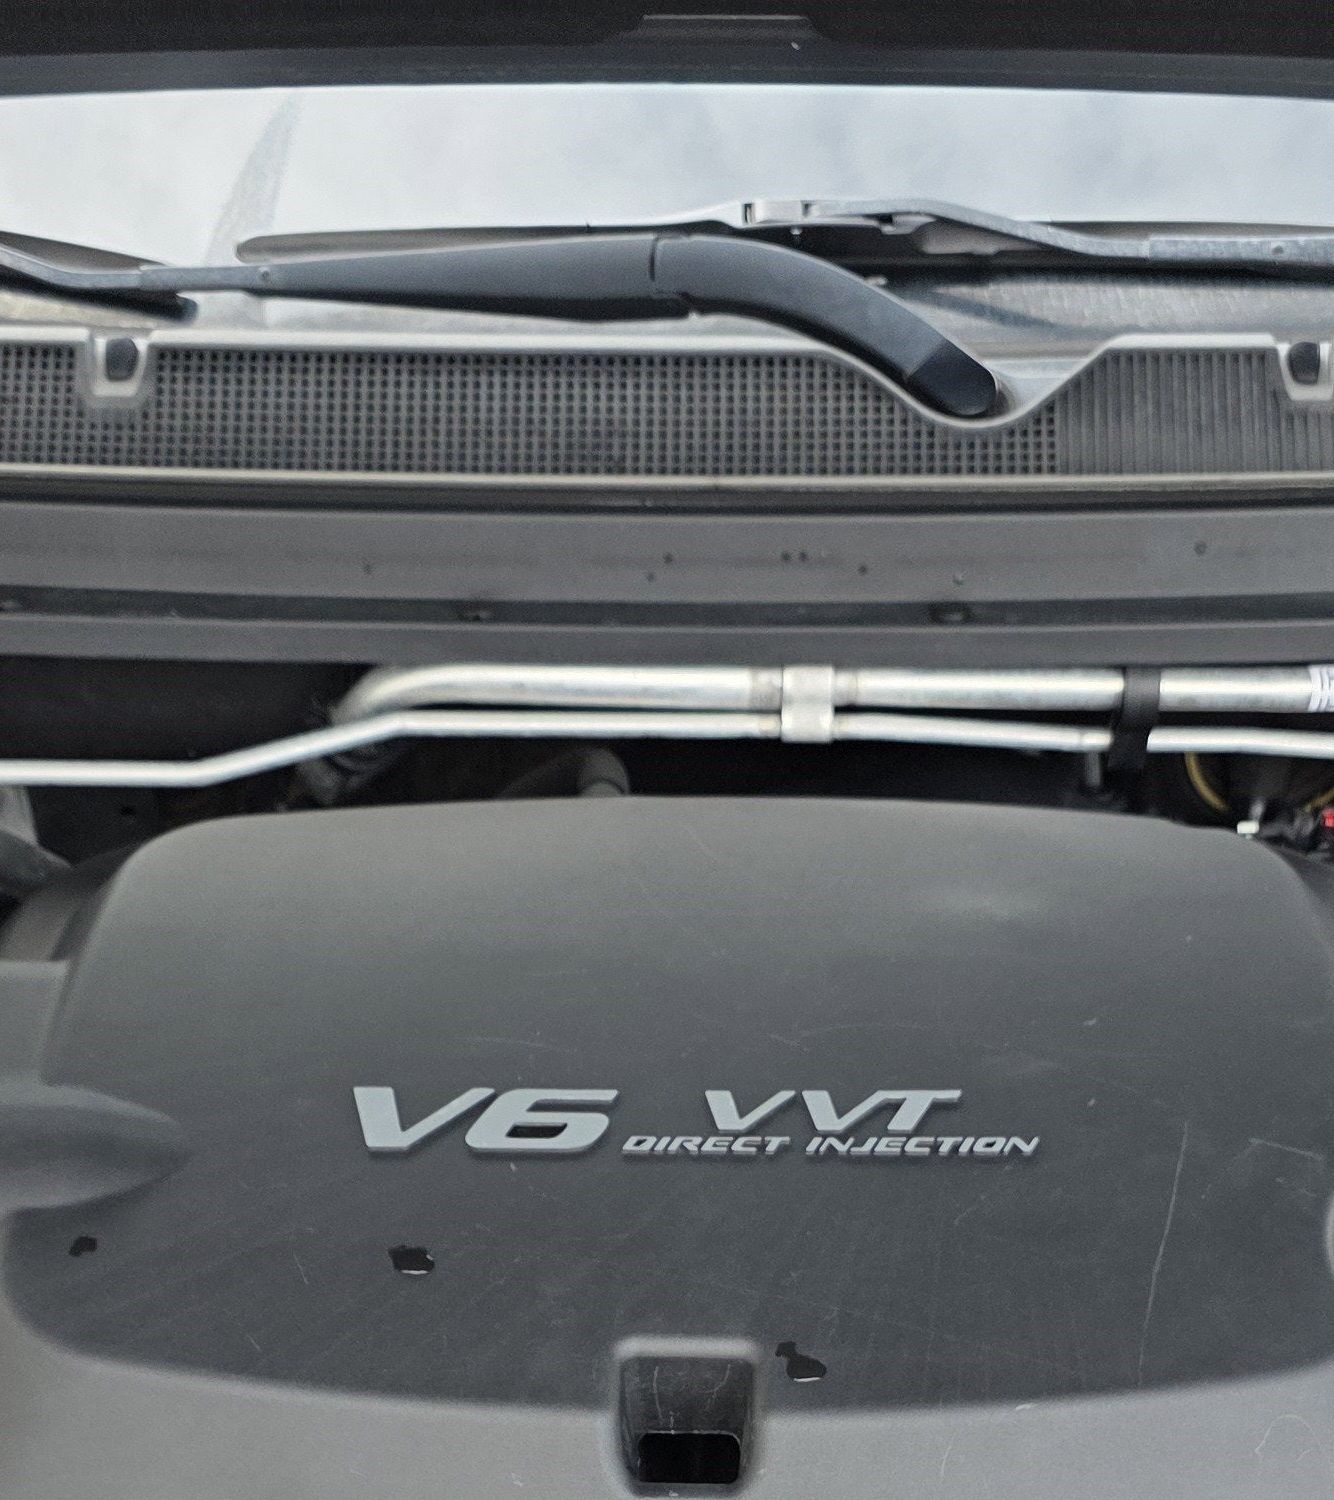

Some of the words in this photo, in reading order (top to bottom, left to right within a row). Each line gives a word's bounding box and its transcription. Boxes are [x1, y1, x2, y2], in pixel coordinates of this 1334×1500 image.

[353, 1086, 617, 1151] V6
[704, 1089, 963, 1131] VVT
[622, 1136, 789, 1155] DIRECT
[806, 1136, 1039, 1156] INJECTION
